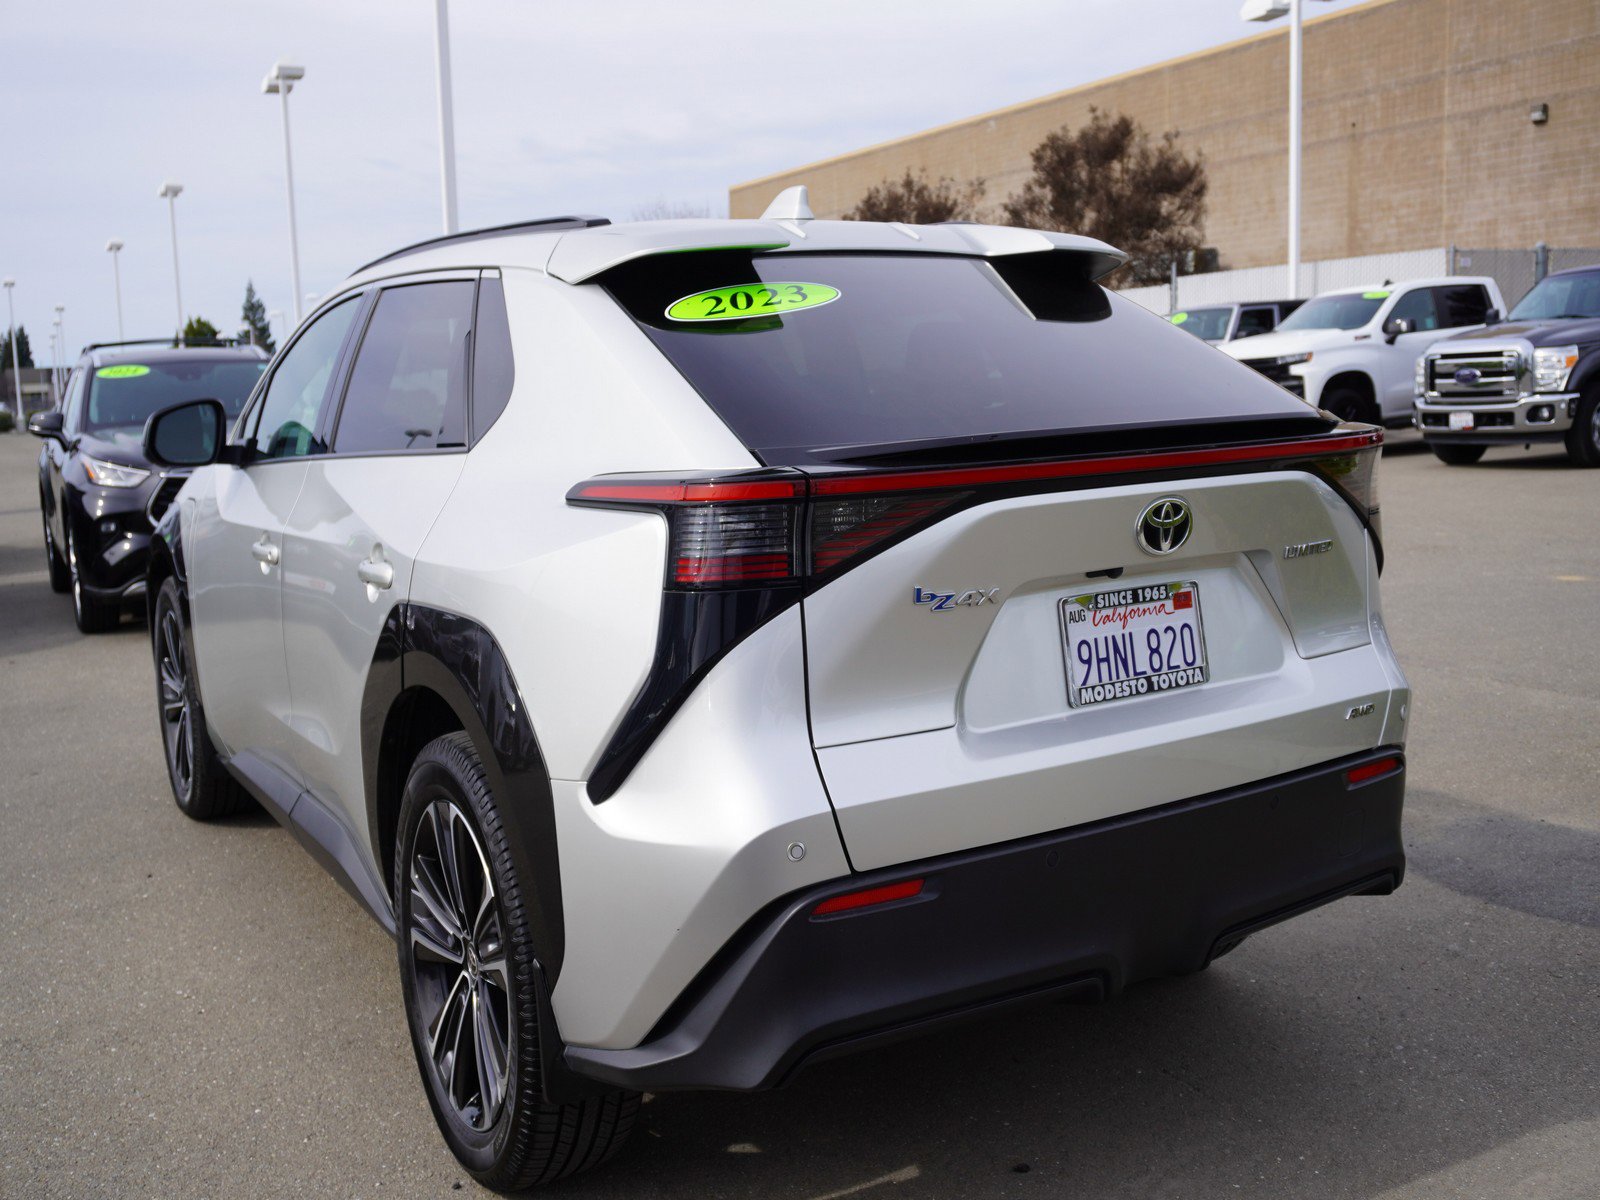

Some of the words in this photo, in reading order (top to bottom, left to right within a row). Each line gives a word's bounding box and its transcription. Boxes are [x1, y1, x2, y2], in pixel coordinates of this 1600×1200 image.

[701, 284, 808, 317] 2023
[1096, 590, 1133, 608] SINCE
[1138, 585, 1167, 602] 1965
[1068, 608, 1087, 625] AUG
[1091, 602, 1175, 630] California
[1080, 679, 1148, 706] MODESTO
[1151, 667, 1205, 692] TOYOTA
